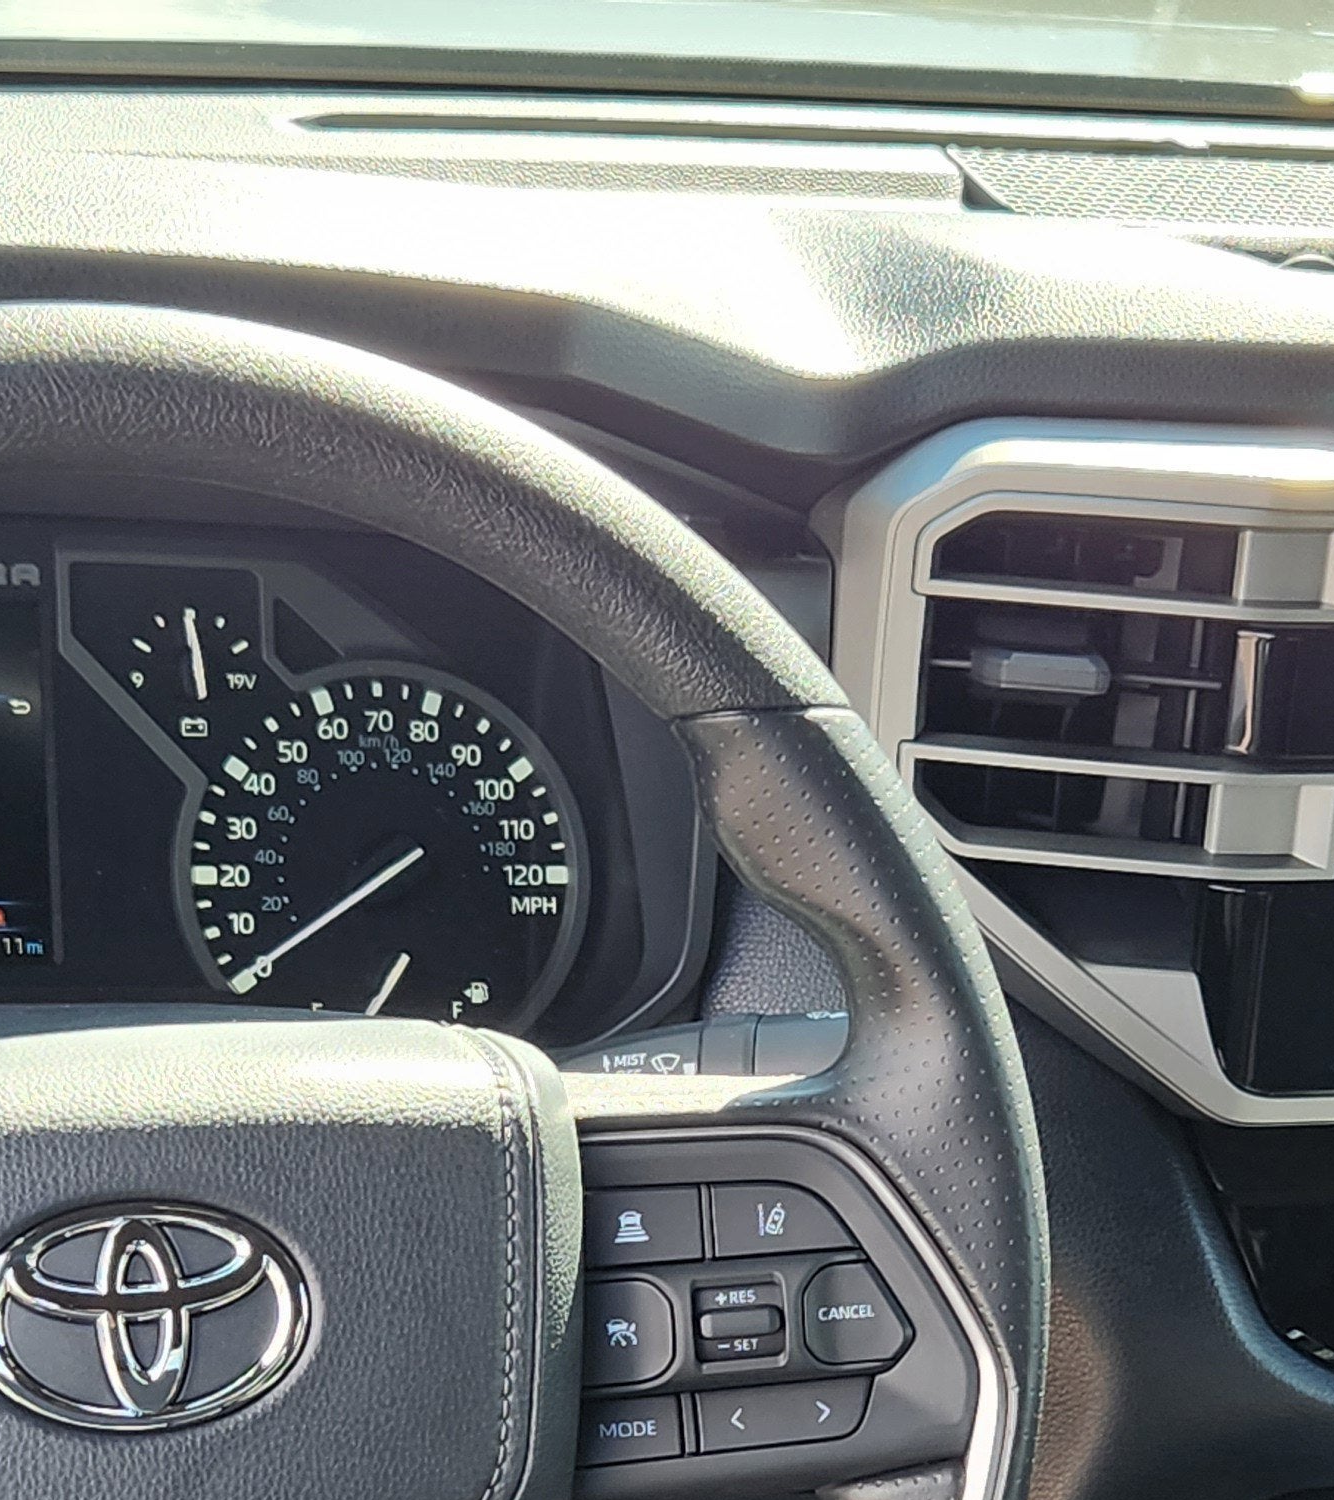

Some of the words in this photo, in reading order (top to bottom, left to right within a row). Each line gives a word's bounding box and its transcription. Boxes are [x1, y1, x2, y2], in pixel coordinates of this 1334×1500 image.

[130, 671, 144, 689] 9
[225, 672, 257, 690] 19V
[317, 717, 349, 740] 60
[364, 710, 394, 732] 70
[409, 720, 440, 742] 80
[358, 734, 400, 749] km/h
[277, 741, 308, 764] 50
[337, 750, 365, 766] 100
[385, 749, 412, 764] 120
[451, 743, 482, 767] 90
[297, 768, 319, 785] 80
[426, 763, 456, 778] 140
[243, 772, 277, 797] 40
[474, 778, 515, 801] 100
[267, 806, 289, 822] 60
[468, 802, 495, 816] 160
[226, 816, 257, 840] 30
[499, 819, 535, 841] 110
[254, 849, 277, 865] 40
[487, 841, 516, 857] 180
[218, 864, 250, 887] 20
[502, 864, 543, 886] 120
[262, 896, 282, 912] 20
[510, 896, 557, 915] MPH
[227, 912, 255, 935] 10
[451, 1000, 464, 1020] F
[613, 1053, 647, 1068] MIST
[817, 1303, 875, 1323] CANCEL
[599, 1418, 658, 1440] MODE
